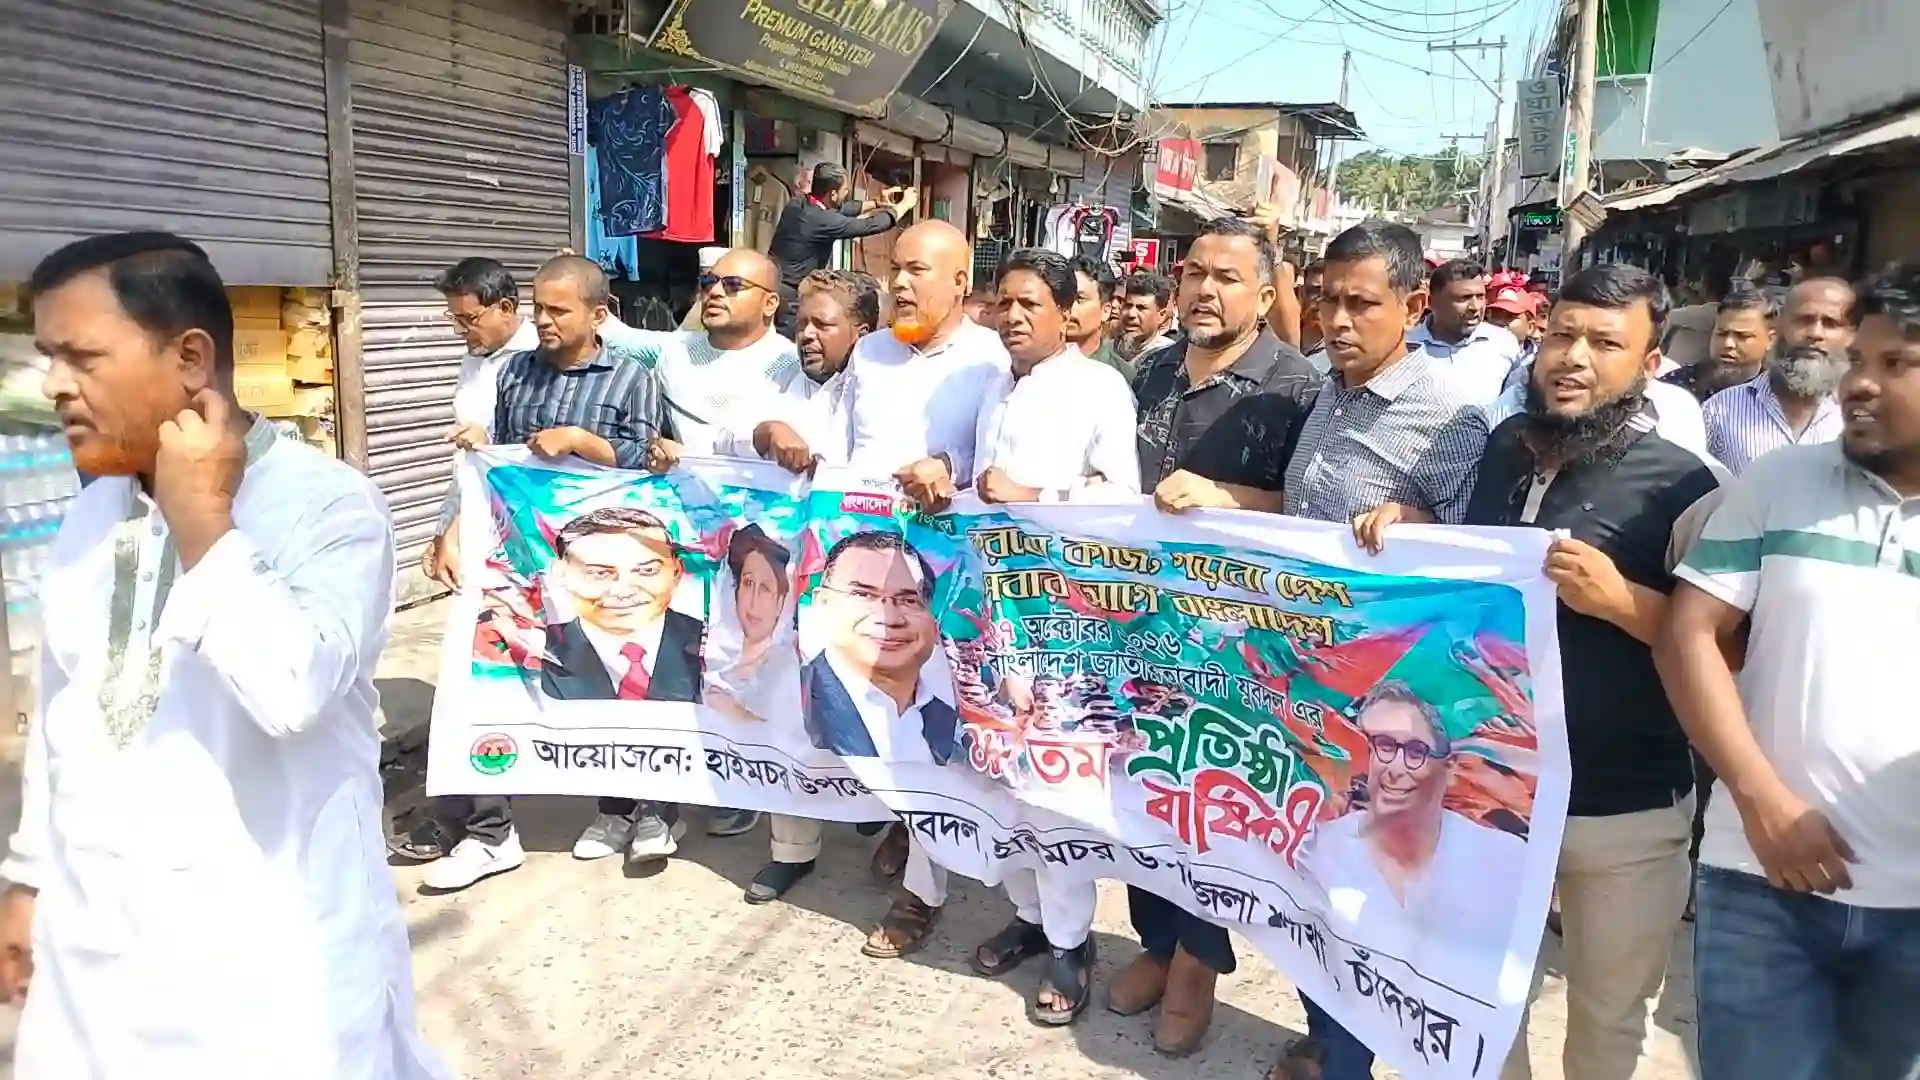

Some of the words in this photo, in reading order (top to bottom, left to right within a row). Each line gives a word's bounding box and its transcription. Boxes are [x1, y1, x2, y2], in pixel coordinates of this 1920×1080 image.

[739, 0, 812, 43] PREMUM
[1276, 571, 1355, 608] দেশ
[1021, 606, 1113, 644] অক্টোবর
[1163, 588, 1335, 648] বাংলাদেশ
[986, 649, 1084, 677] বাংলাদেশ
[1292, 700, 1325, 732] এর
[703, 744, 793, 794] হাইমচর
[1126, 707, 1296, 809] প্রতিষ্ঠা
[1141, 769, 1323, 871] বার্ষিকী
